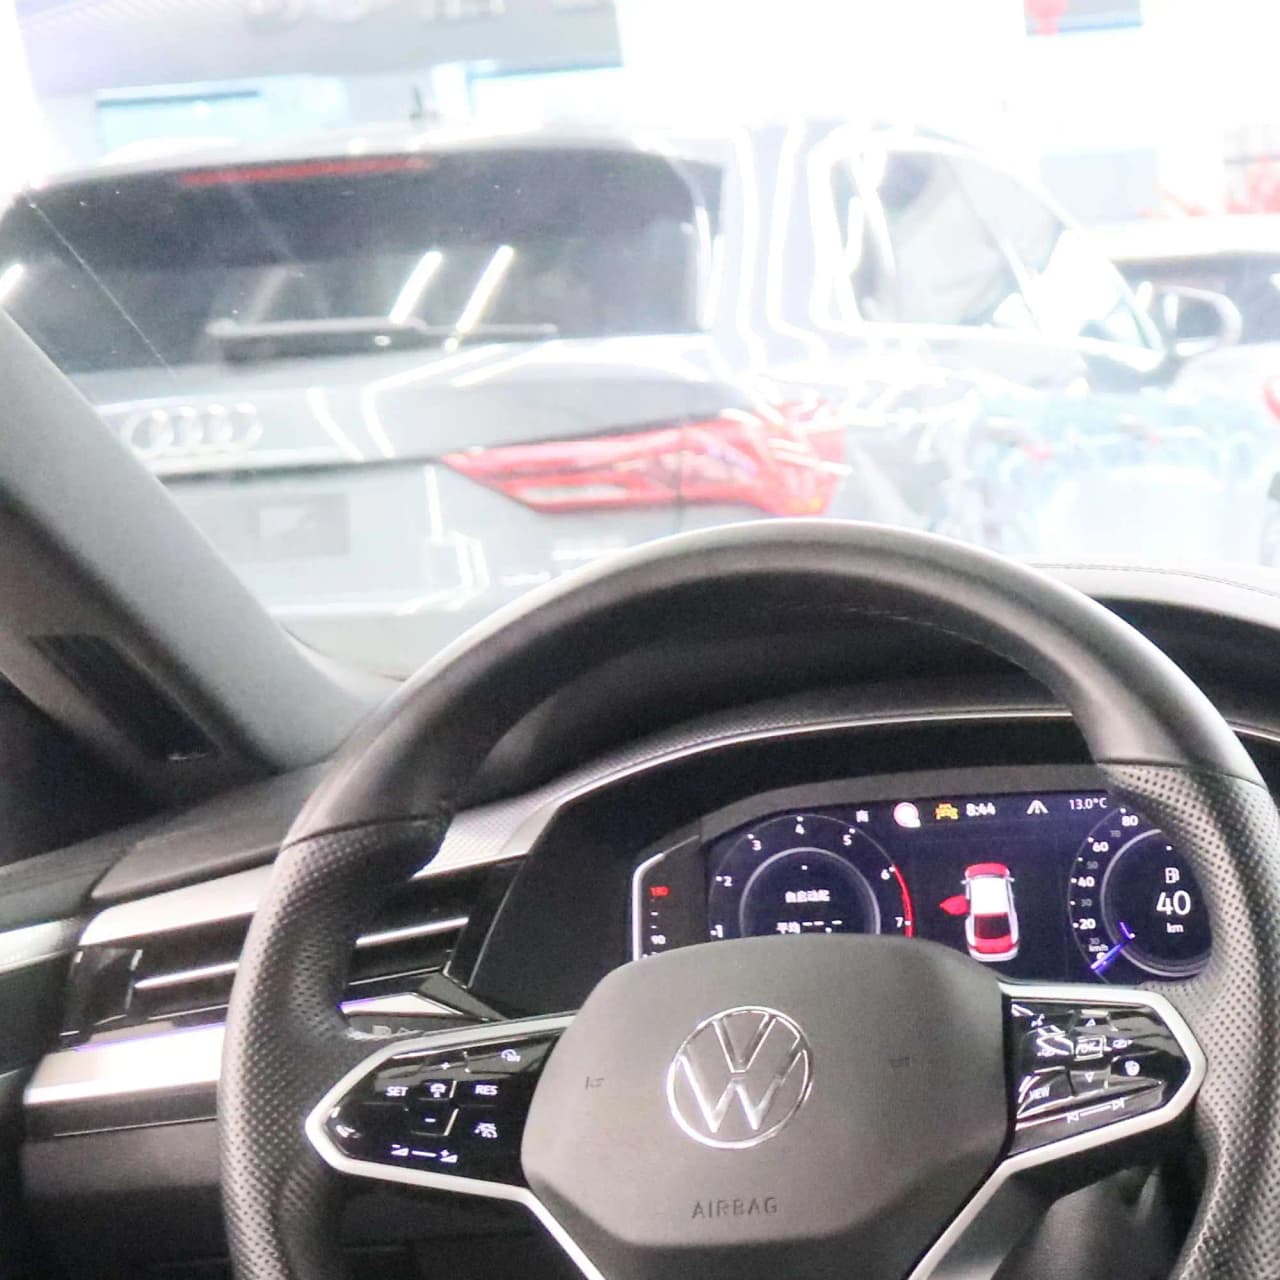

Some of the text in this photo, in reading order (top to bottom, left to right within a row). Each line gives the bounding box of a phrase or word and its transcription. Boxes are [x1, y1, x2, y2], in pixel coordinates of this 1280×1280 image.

[966, 801, 996, 817] 8:44
[1121, 814, 1138, 827] 80
[795, 823, 805, 835] 4
[751, 839, 762, 852] 3
[842, 833, 852, 847] 5
[1092, 840, 1109, 853] 60
[880, 868, 891, 881] 6
[723, 875, 733, 888] 2
[1077, 875, 1095, 888] 40
[1156, 890, 1192, 916] 40
[895, 916, 904, 929] 7
[1079, 918, 1097, 931] 20
[1166, 922, 1184, 934] km
[715, 924, 724, 938] 1
[385, 1086, 409, 1097] SET
[474, 1084, 499, 1096] RES
[691, 1197, 777, 1219] AIRBAG
